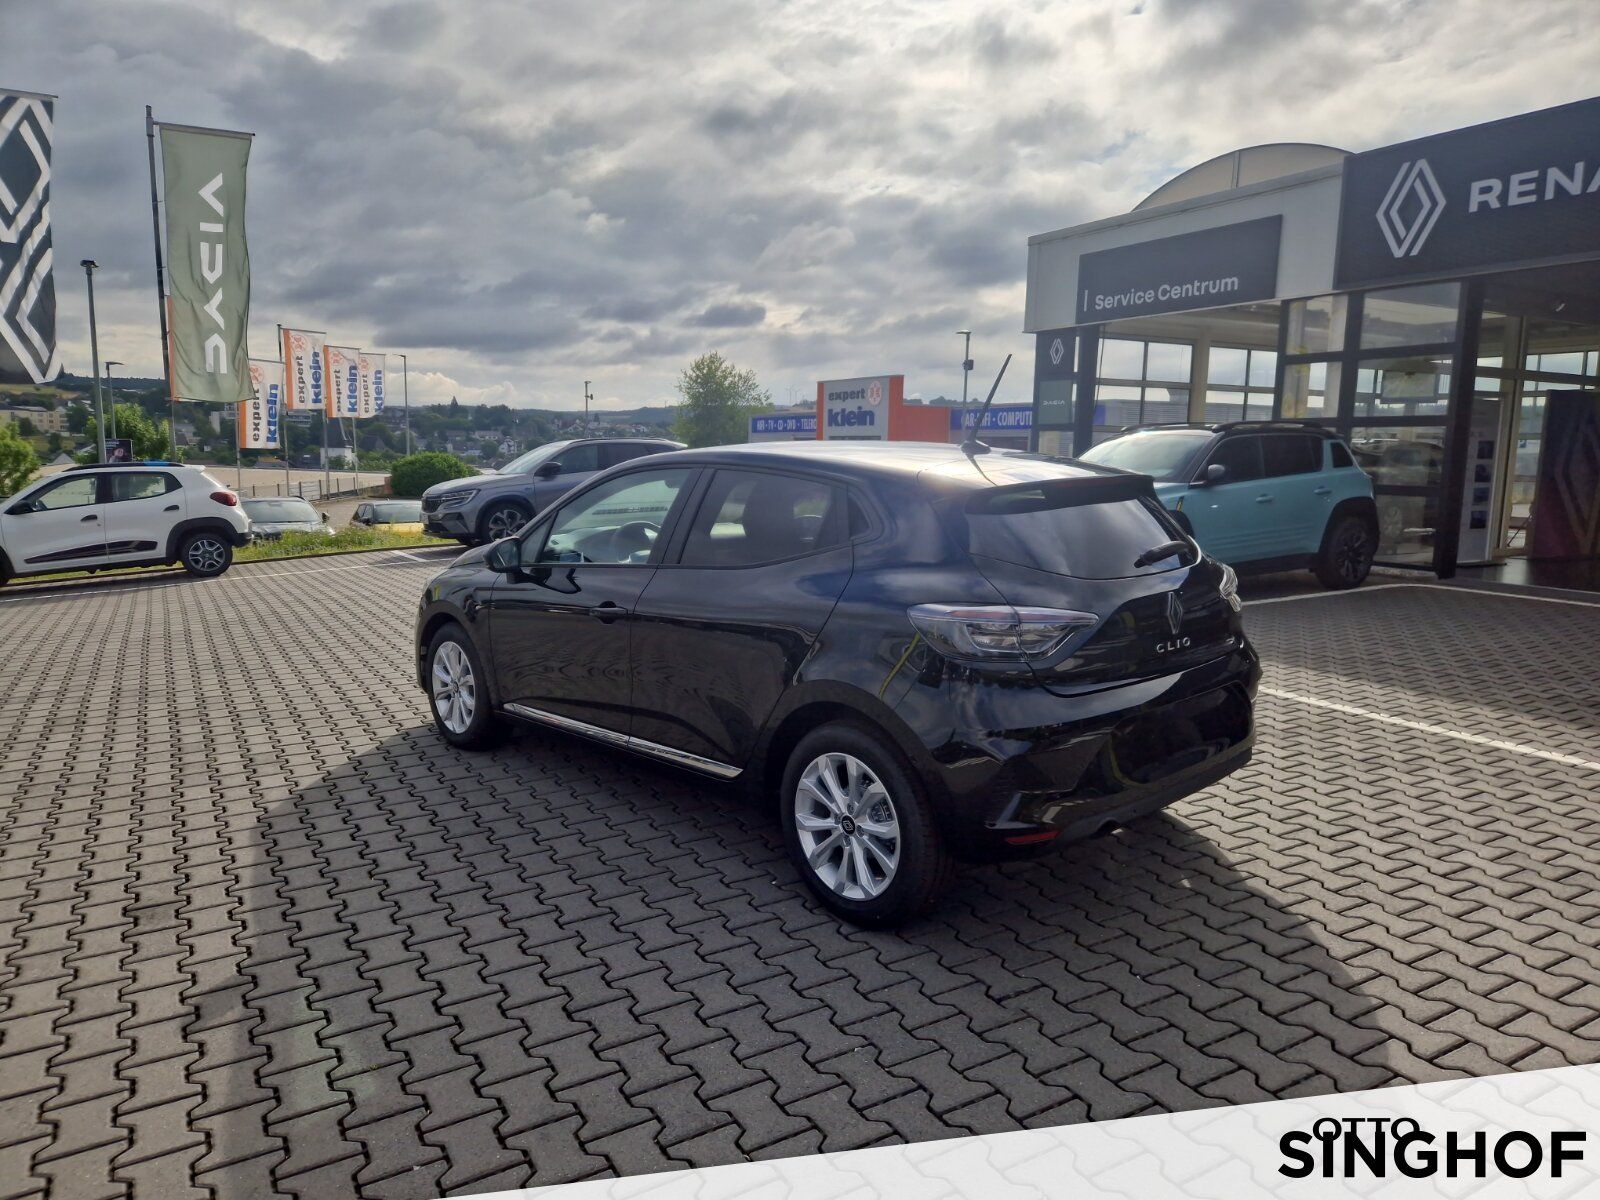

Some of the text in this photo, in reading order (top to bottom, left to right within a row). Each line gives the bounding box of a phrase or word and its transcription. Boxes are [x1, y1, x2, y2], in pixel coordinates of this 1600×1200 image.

[1095, 276, 1239, 310] Service Centrum
[296, 355, 306, 404] expert
[310, 351, 322, 404] klein
[333, 369, 341, 412] expert
[347, 365, 358, 413] klein
[362, 374, 370, 413] expert
[372, 369, 383, 413] klein
[828, 387, 866, 402] expert
[266, 384, 279, 442] klein
[827, 405, 875, 427] klein
[1156, 636, 1191, 654] CLIO
